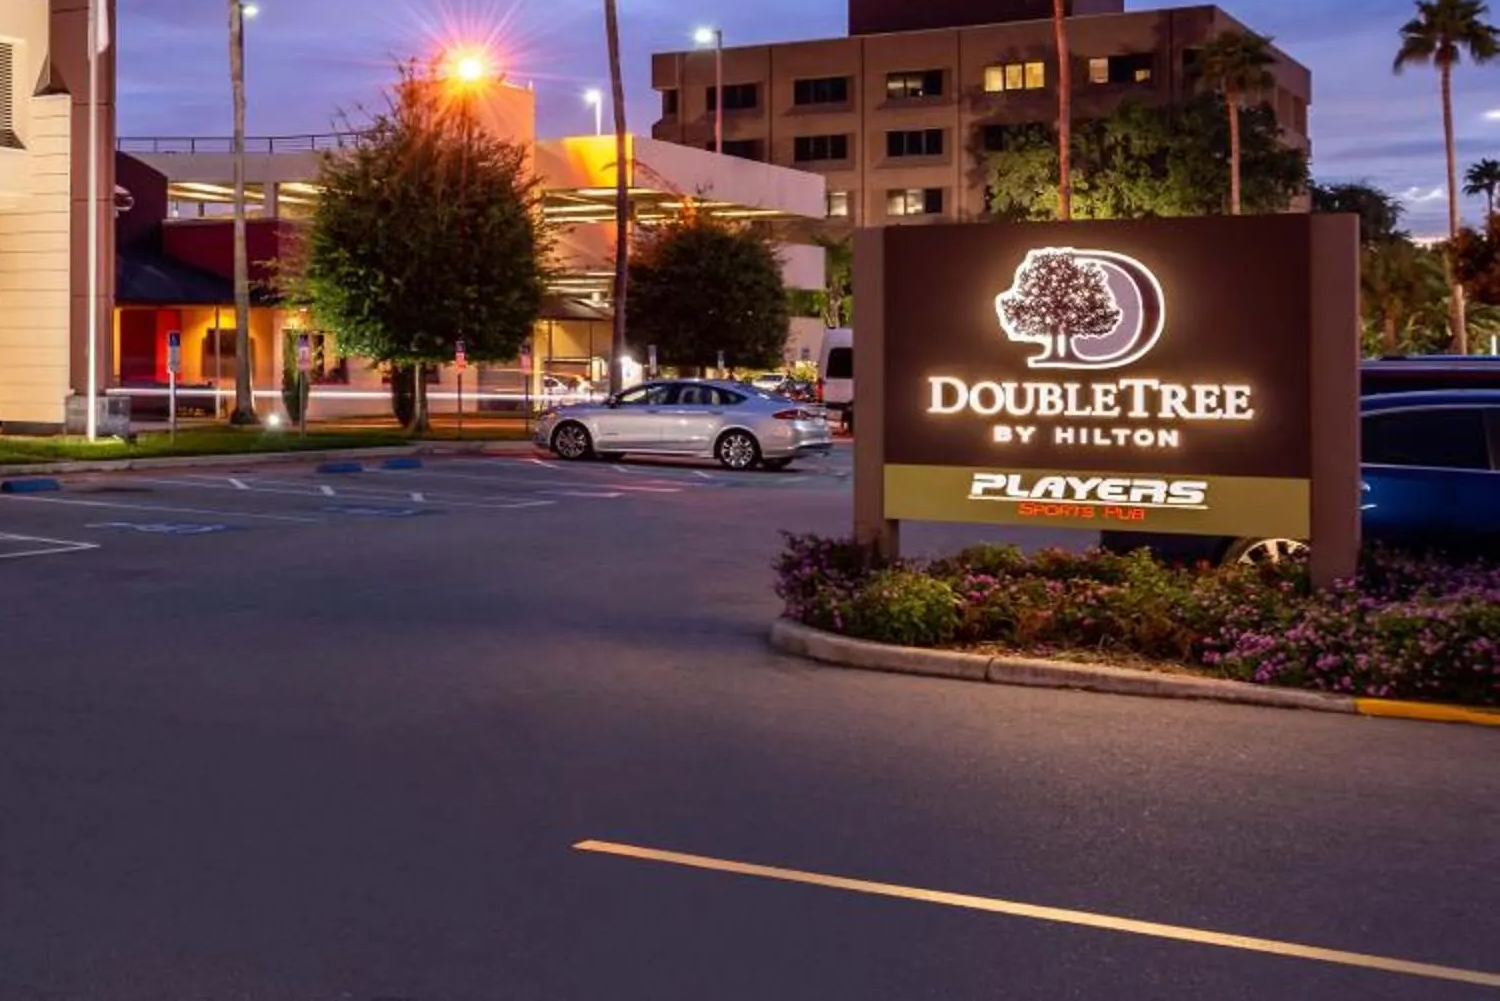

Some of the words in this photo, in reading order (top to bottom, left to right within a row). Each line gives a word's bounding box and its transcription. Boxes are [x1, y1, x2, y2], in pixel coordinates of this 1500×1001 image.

[993, 426, 1037, 443] BY
[1055, 426, 1180, 448] HILTON
[971, 473, 1208, 505] PLAYERS
[1018, 502, 1095, 519] SPORTS
[1105, 507, 1146, 521] PUB
